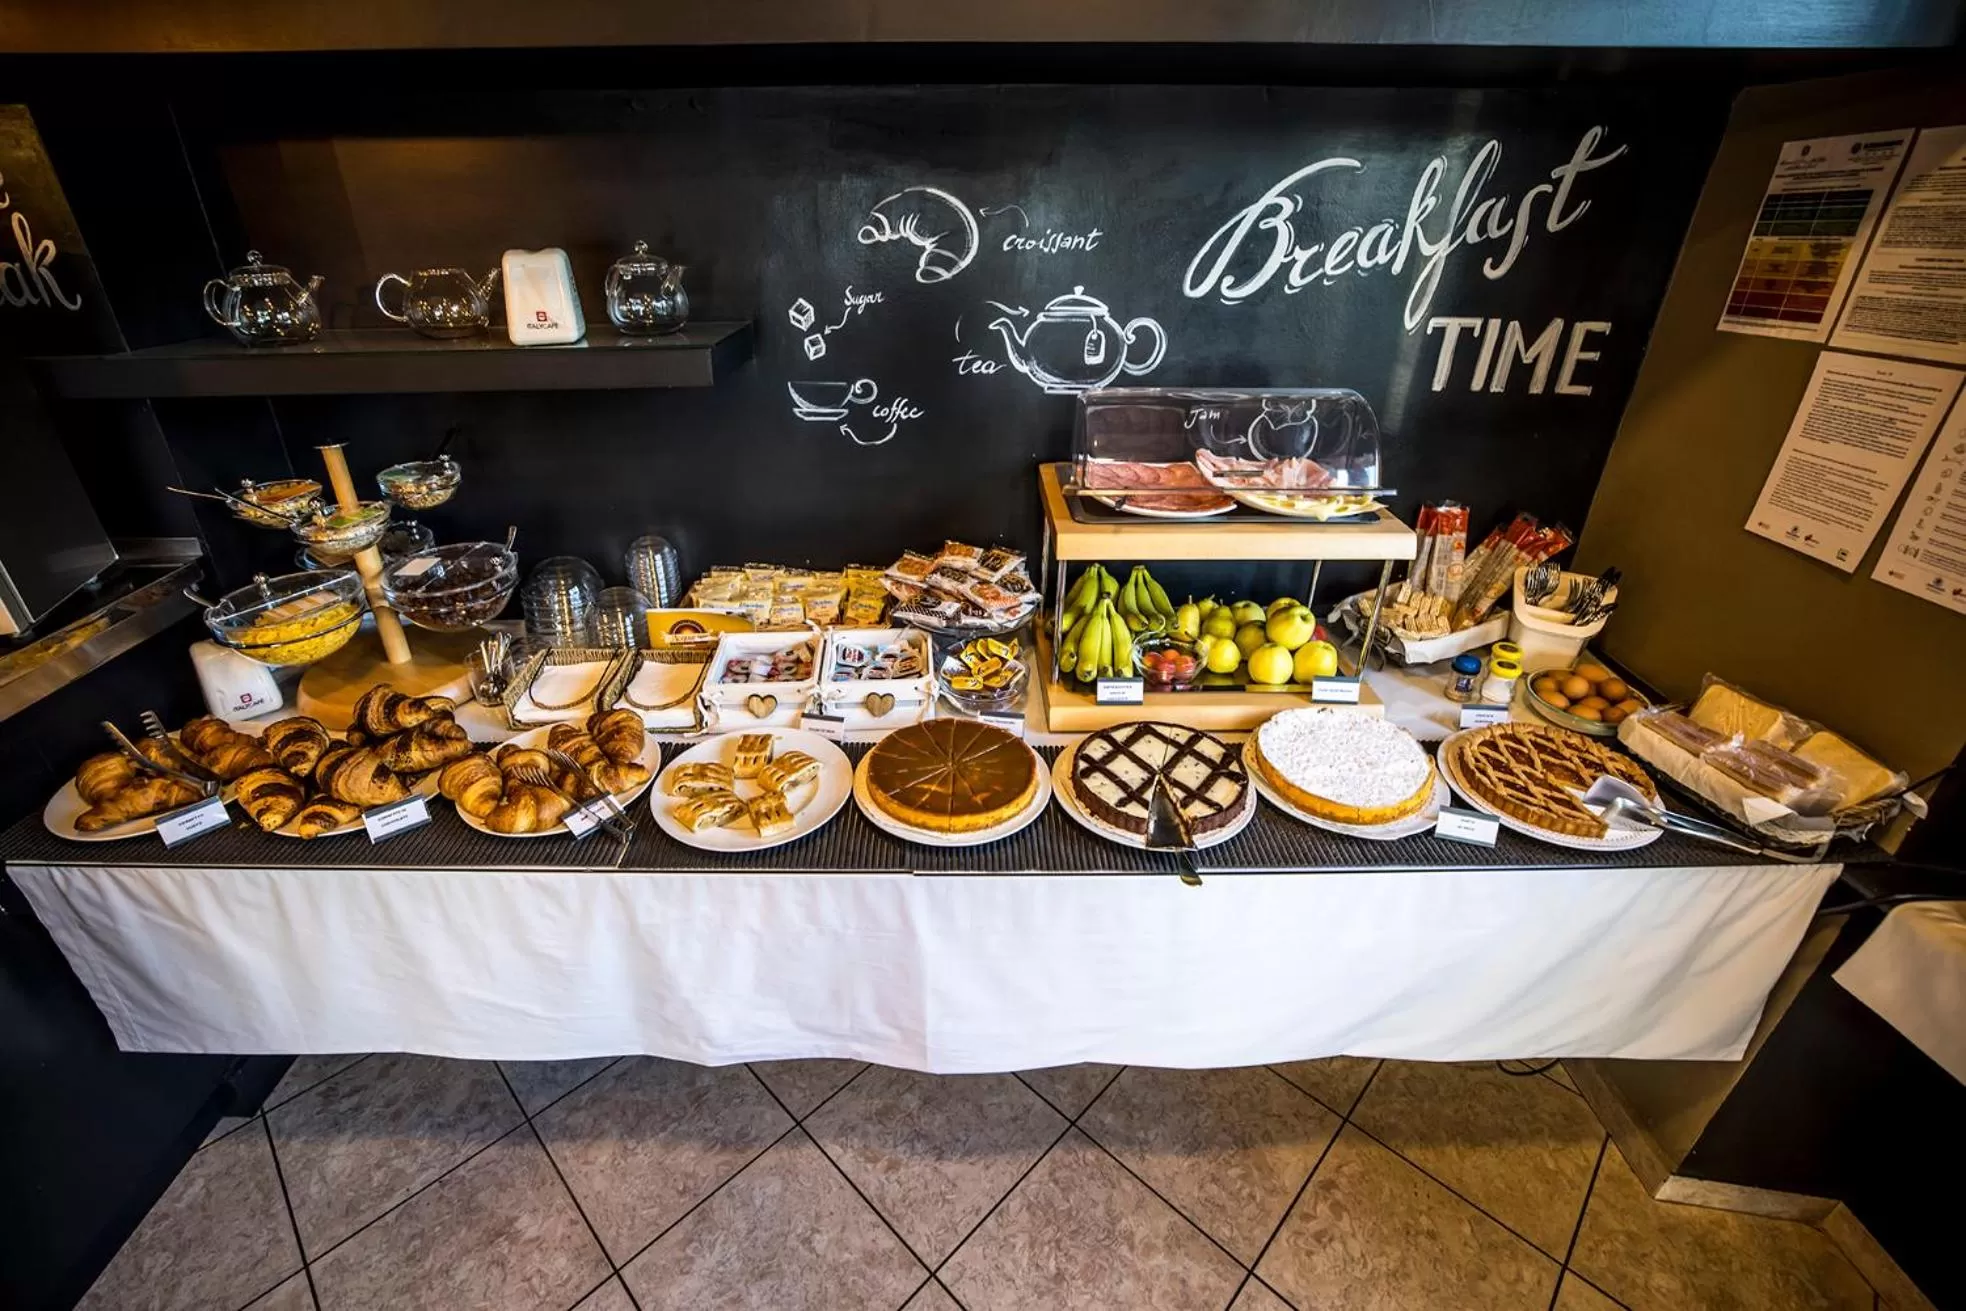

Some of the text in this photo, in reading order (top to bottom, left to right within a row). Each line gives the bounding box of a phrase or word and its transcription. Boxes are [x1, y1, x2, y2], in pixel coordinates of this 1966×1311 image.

[1002, 227, 1104, 252] croissant
[1183, 125, 1628, 333] Breakfast
[843, 284, 885, 315] Sugar
[951, 349, 1007, 376] tea
[1426, 316, 1612, 396] TIME
[871, 396, 924, 423] coffee
